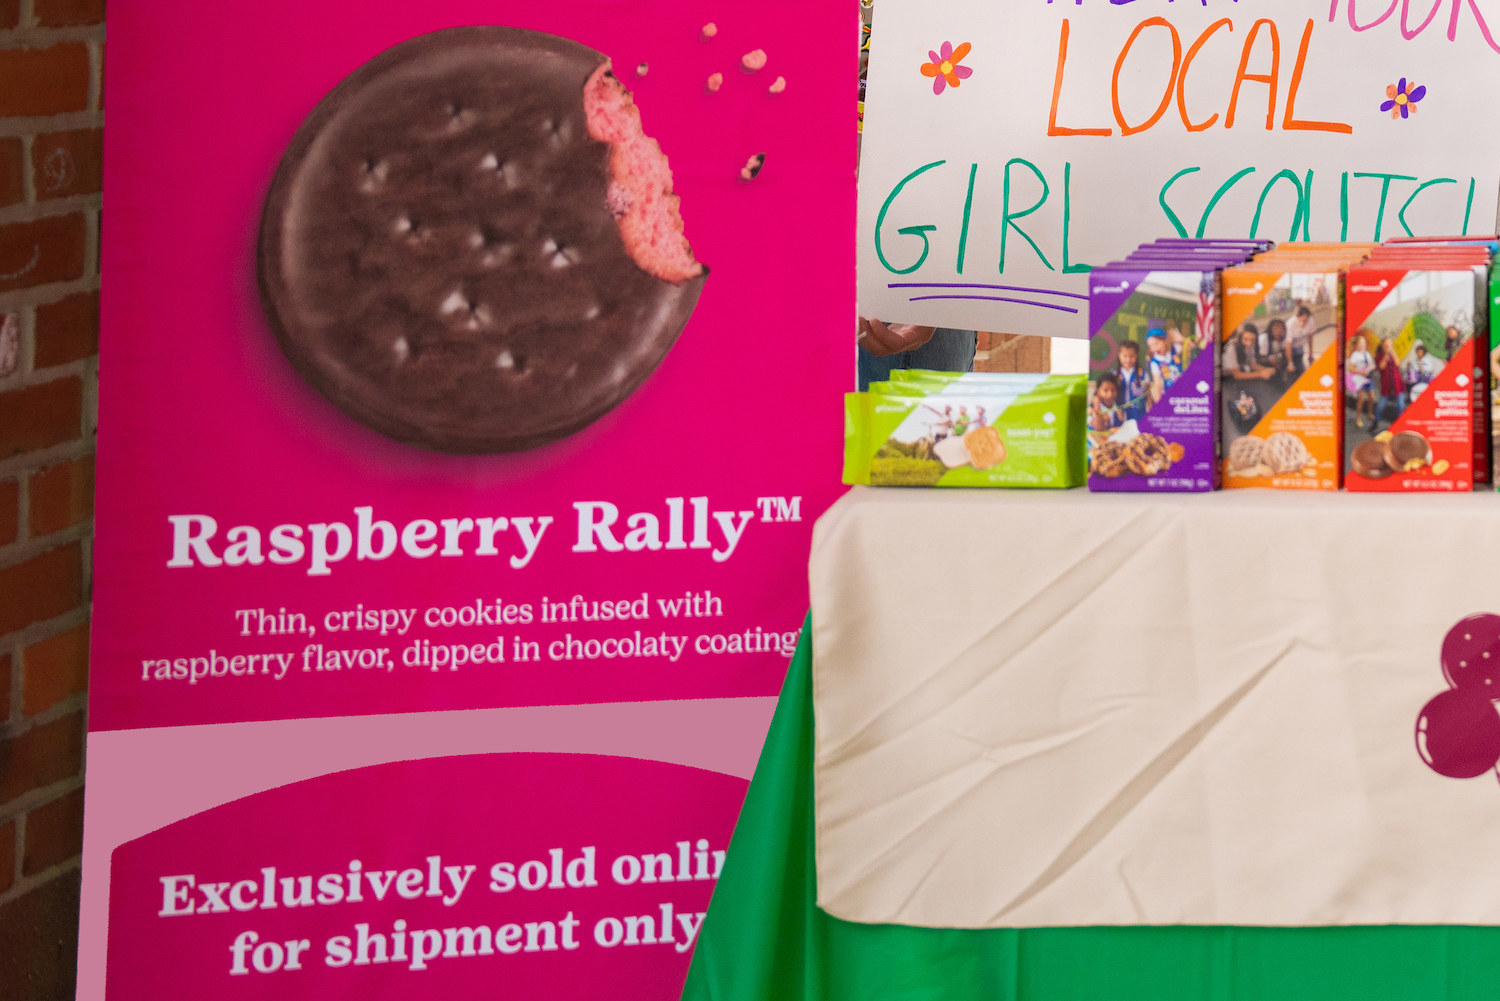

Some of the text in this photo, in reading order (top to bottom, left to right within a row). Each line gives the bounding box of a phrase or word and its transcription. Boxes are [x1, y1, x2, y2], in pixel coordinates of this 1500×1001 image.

[1047, 16, 1353, 137] LOCAL
[874, 157, 1092, 275] GIRL
[166, 505, 553, 576] Raspberry
[236, 590, 723, 637] Thin, crispy cookies infused with
[141, 650, 295, 684] raspberry
[302, 644, 394, 672] flavor,
[402, 635, 505, 672] dipped
[513, 635, 541, 662] in
[548, 630, 688, 662] chocolaty
[158, 855, 477, 917] Exclusively
[489, 845, 598, 893] sold
[229, 902, 707, 975] for shipment only
